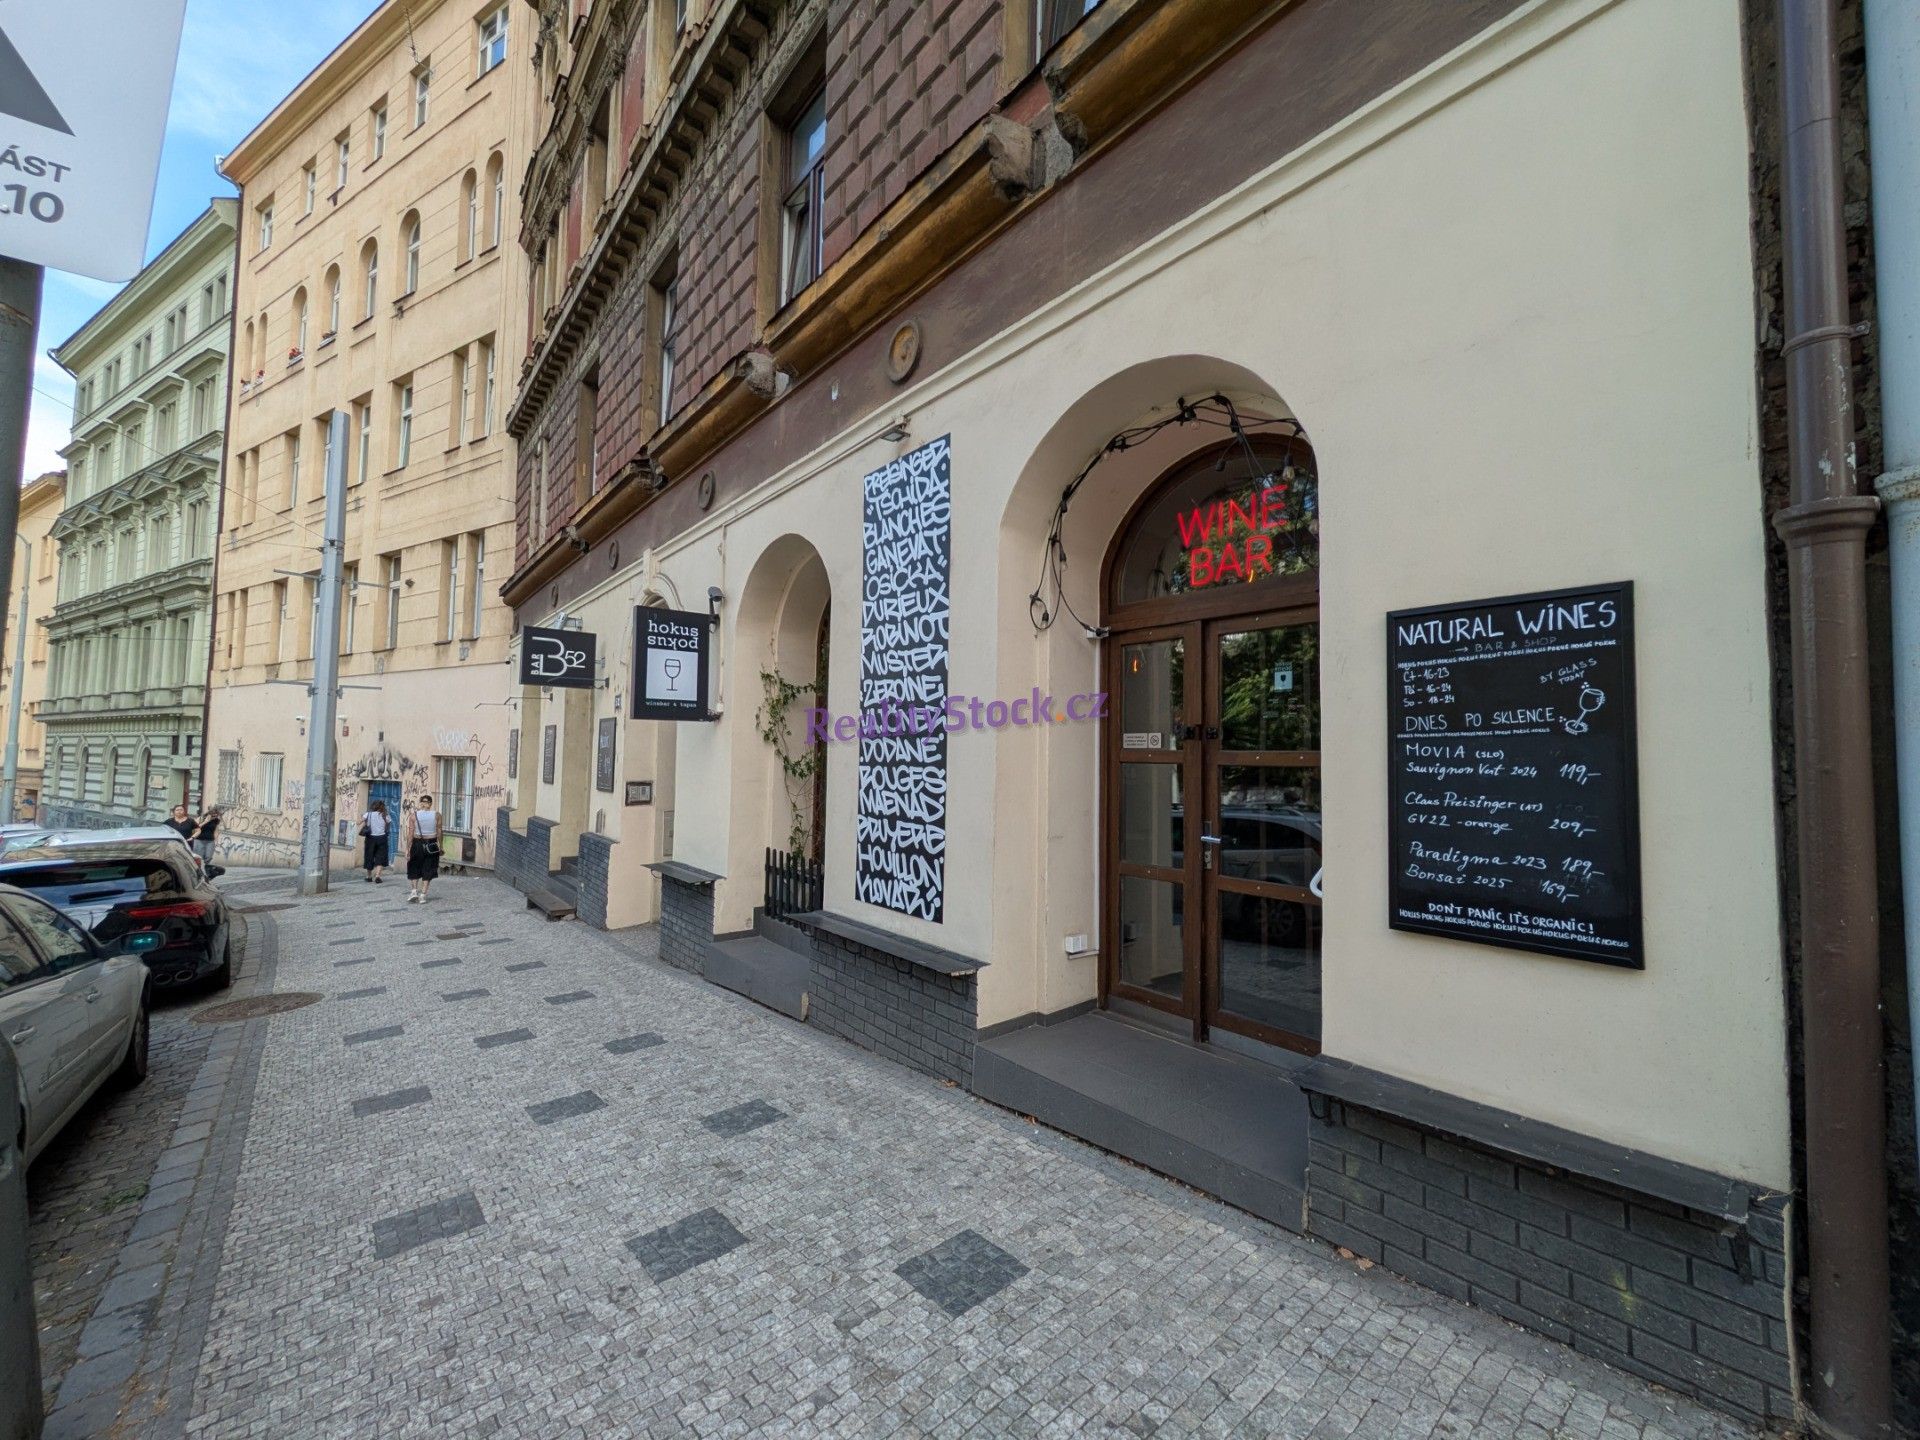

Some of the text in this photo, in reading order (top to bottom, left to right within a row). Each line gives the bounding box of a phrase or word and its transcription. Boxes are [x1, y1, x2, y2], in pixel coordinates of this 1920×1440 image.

[865, 440, 950, 497] PREISINGER
[863, 493, 950, 549] BLANCHES
[1177, 484, 1289, 549] WINE
[1190, 534, 1273, 587] BAR
[648, 620, 698, 637] hokus
[862, 609, 949, 653] ROBINOT
[1399, 614, 1504, 646] NATURAL
[532, 636, 586, 677] B52
[861, 643, 948, 679] MUSTER
[1475, 642, 1504, 653] BAR
[530, 653, 541, 675] BAR
[1538, 658, 1597, 684] BY GLASS
[1558, 670, 1585, 685] TODAY
[1405, 707, 1555, 732] DNES PO SKLENCE
[862, 736, 942, 763] DODANE
[1406, 742, 1465, 758] MOVIA
[860, 765, 946, 793] ROUGES
[1406, 762, 1474, 780] Sauvignon
[1510, 765, 1537, 777] 2024
[860, 789, 945, 822] MAENAD
[1444, 791, 1516, 813] Preisinger
[858, 843, 943, 891] HOUILLON
[1410, 841, 1508, 871] Paradigma
[1512, 856, 1547, 869] 2023
[1405, 864, 1465, 884] Bonsai
[1473, 875, 1513, 888] 2025
